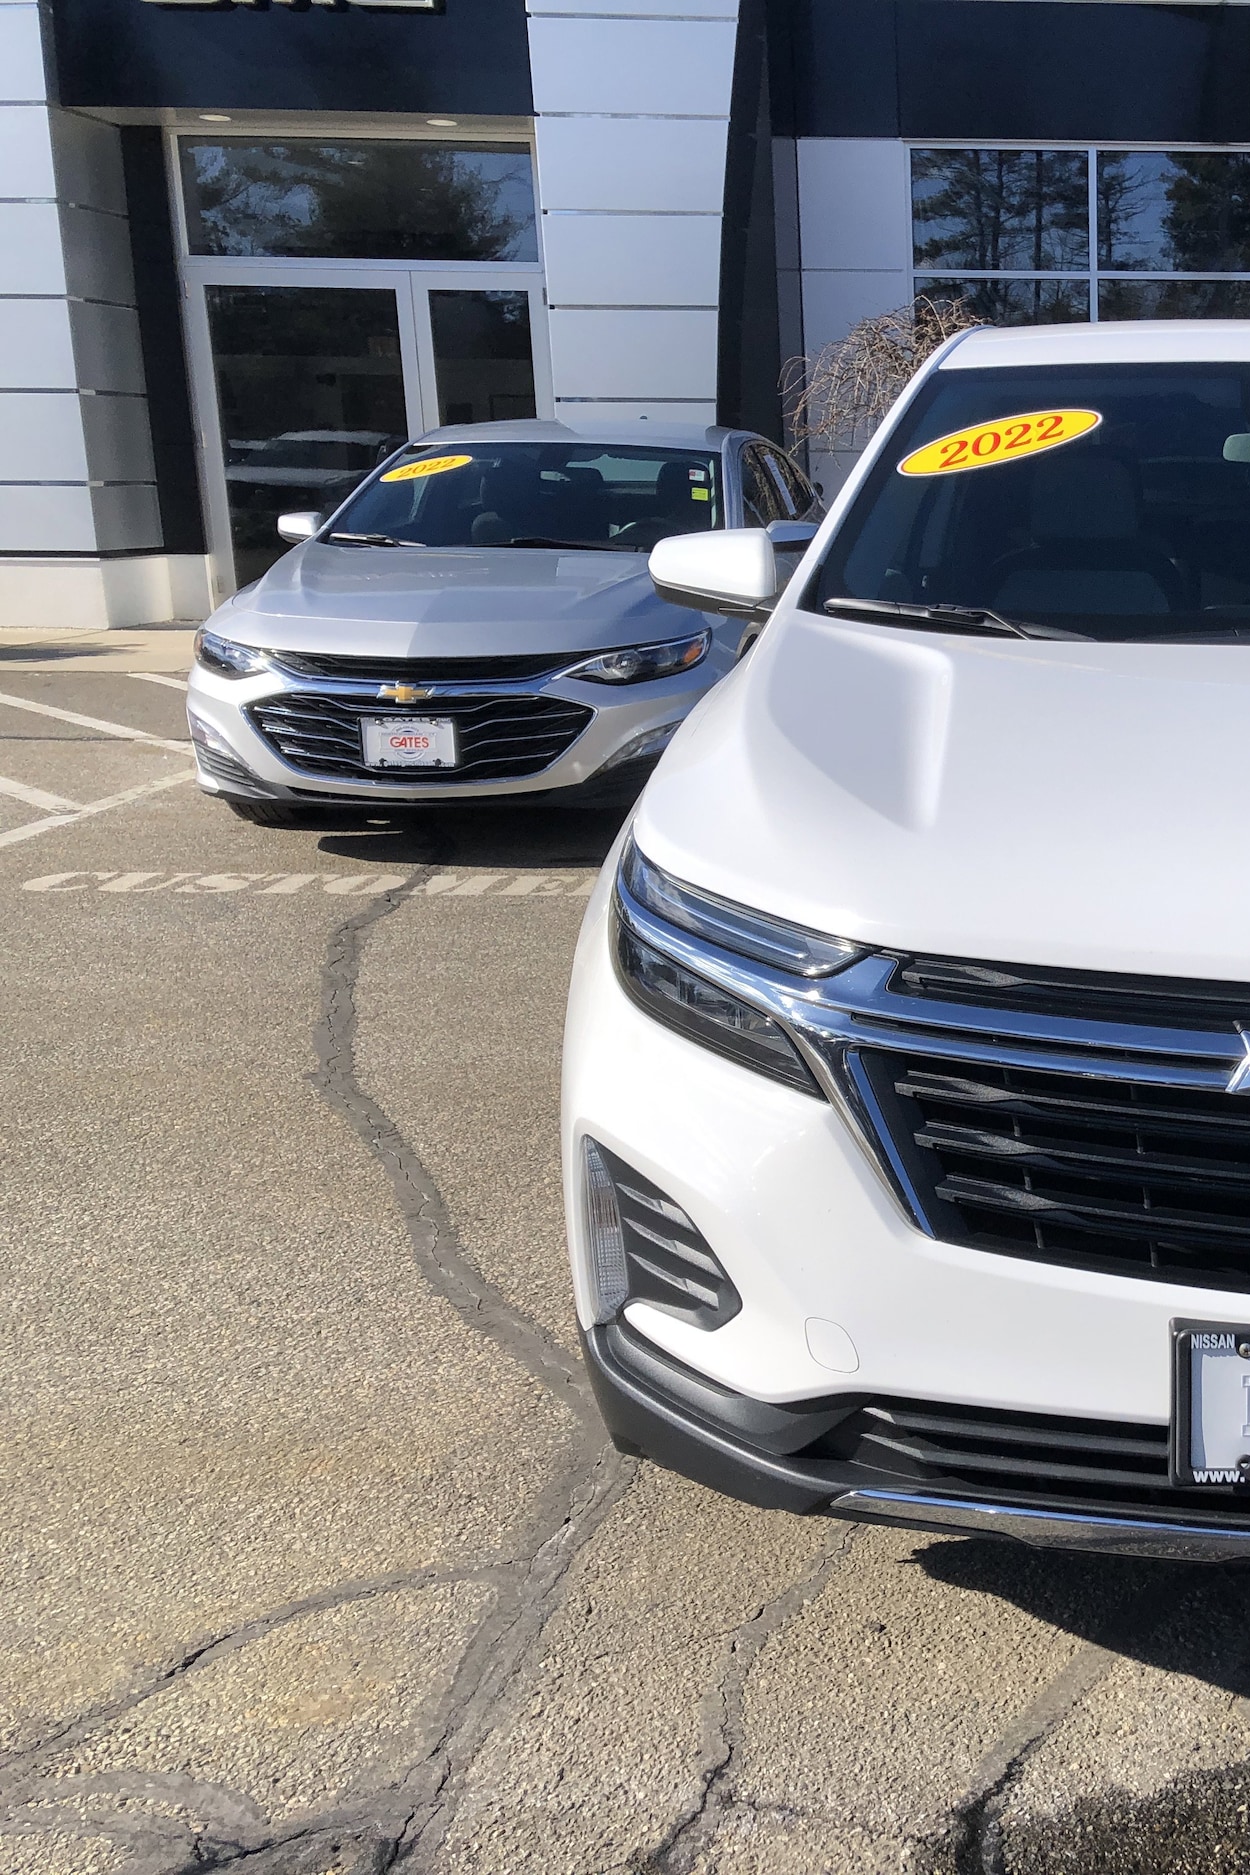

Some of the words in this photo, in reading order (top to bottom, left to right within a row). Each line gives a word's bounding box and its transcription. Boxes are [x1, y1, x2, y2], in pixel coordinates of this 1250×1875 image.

[938, 415, 1064, 469] 2022
[397, 458, 456, 477] 2022
[390, 737, 429, 748] GATES
[22, 872, 598, 896] CUSTOME
[1190, 1334, 1236, 1349] NISSAN
[1193, 1470, 1246, 1483] www.
